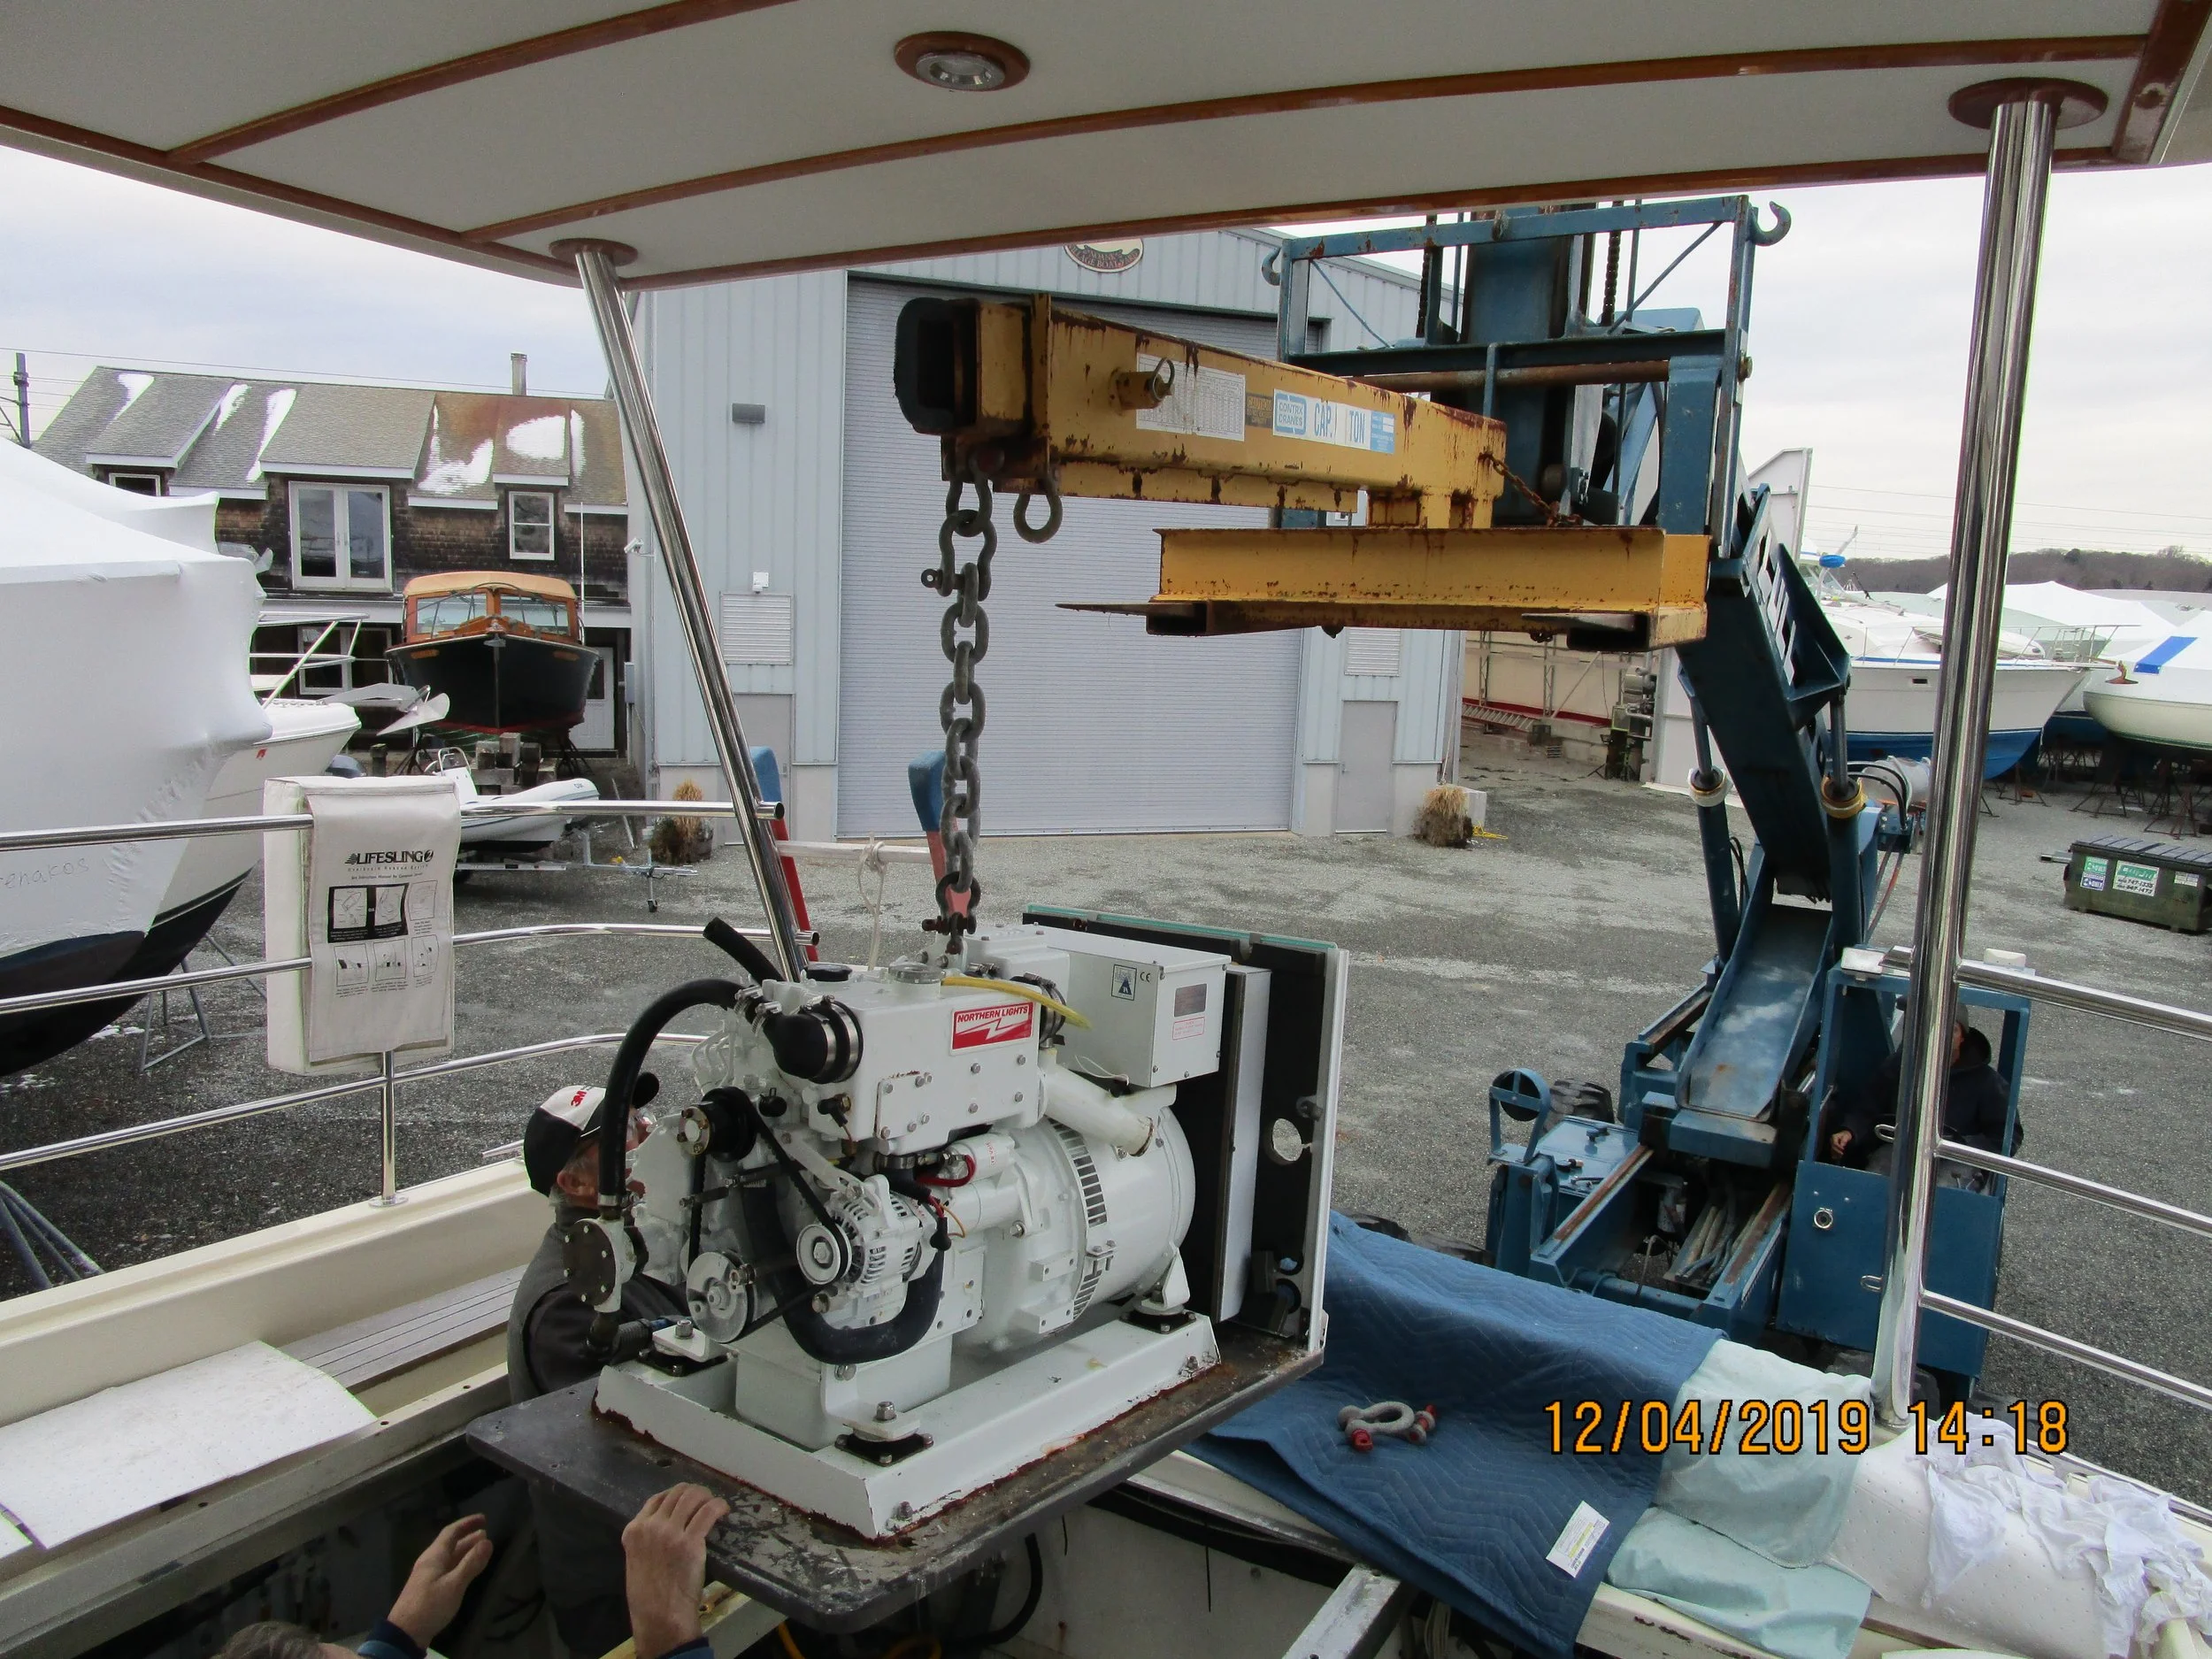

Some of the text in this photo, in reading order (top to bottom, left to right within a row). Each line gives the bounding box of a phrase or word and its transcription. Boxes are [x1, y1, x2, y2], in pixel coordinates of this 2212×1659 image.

[1279, 414, 1302, 426] CRANES
[1348, 410, 1365, 444] TON
[957, 1006, 1028, 1023] NORTHERN LIGHTS
[571, 1090, 587, 1107] 3M
